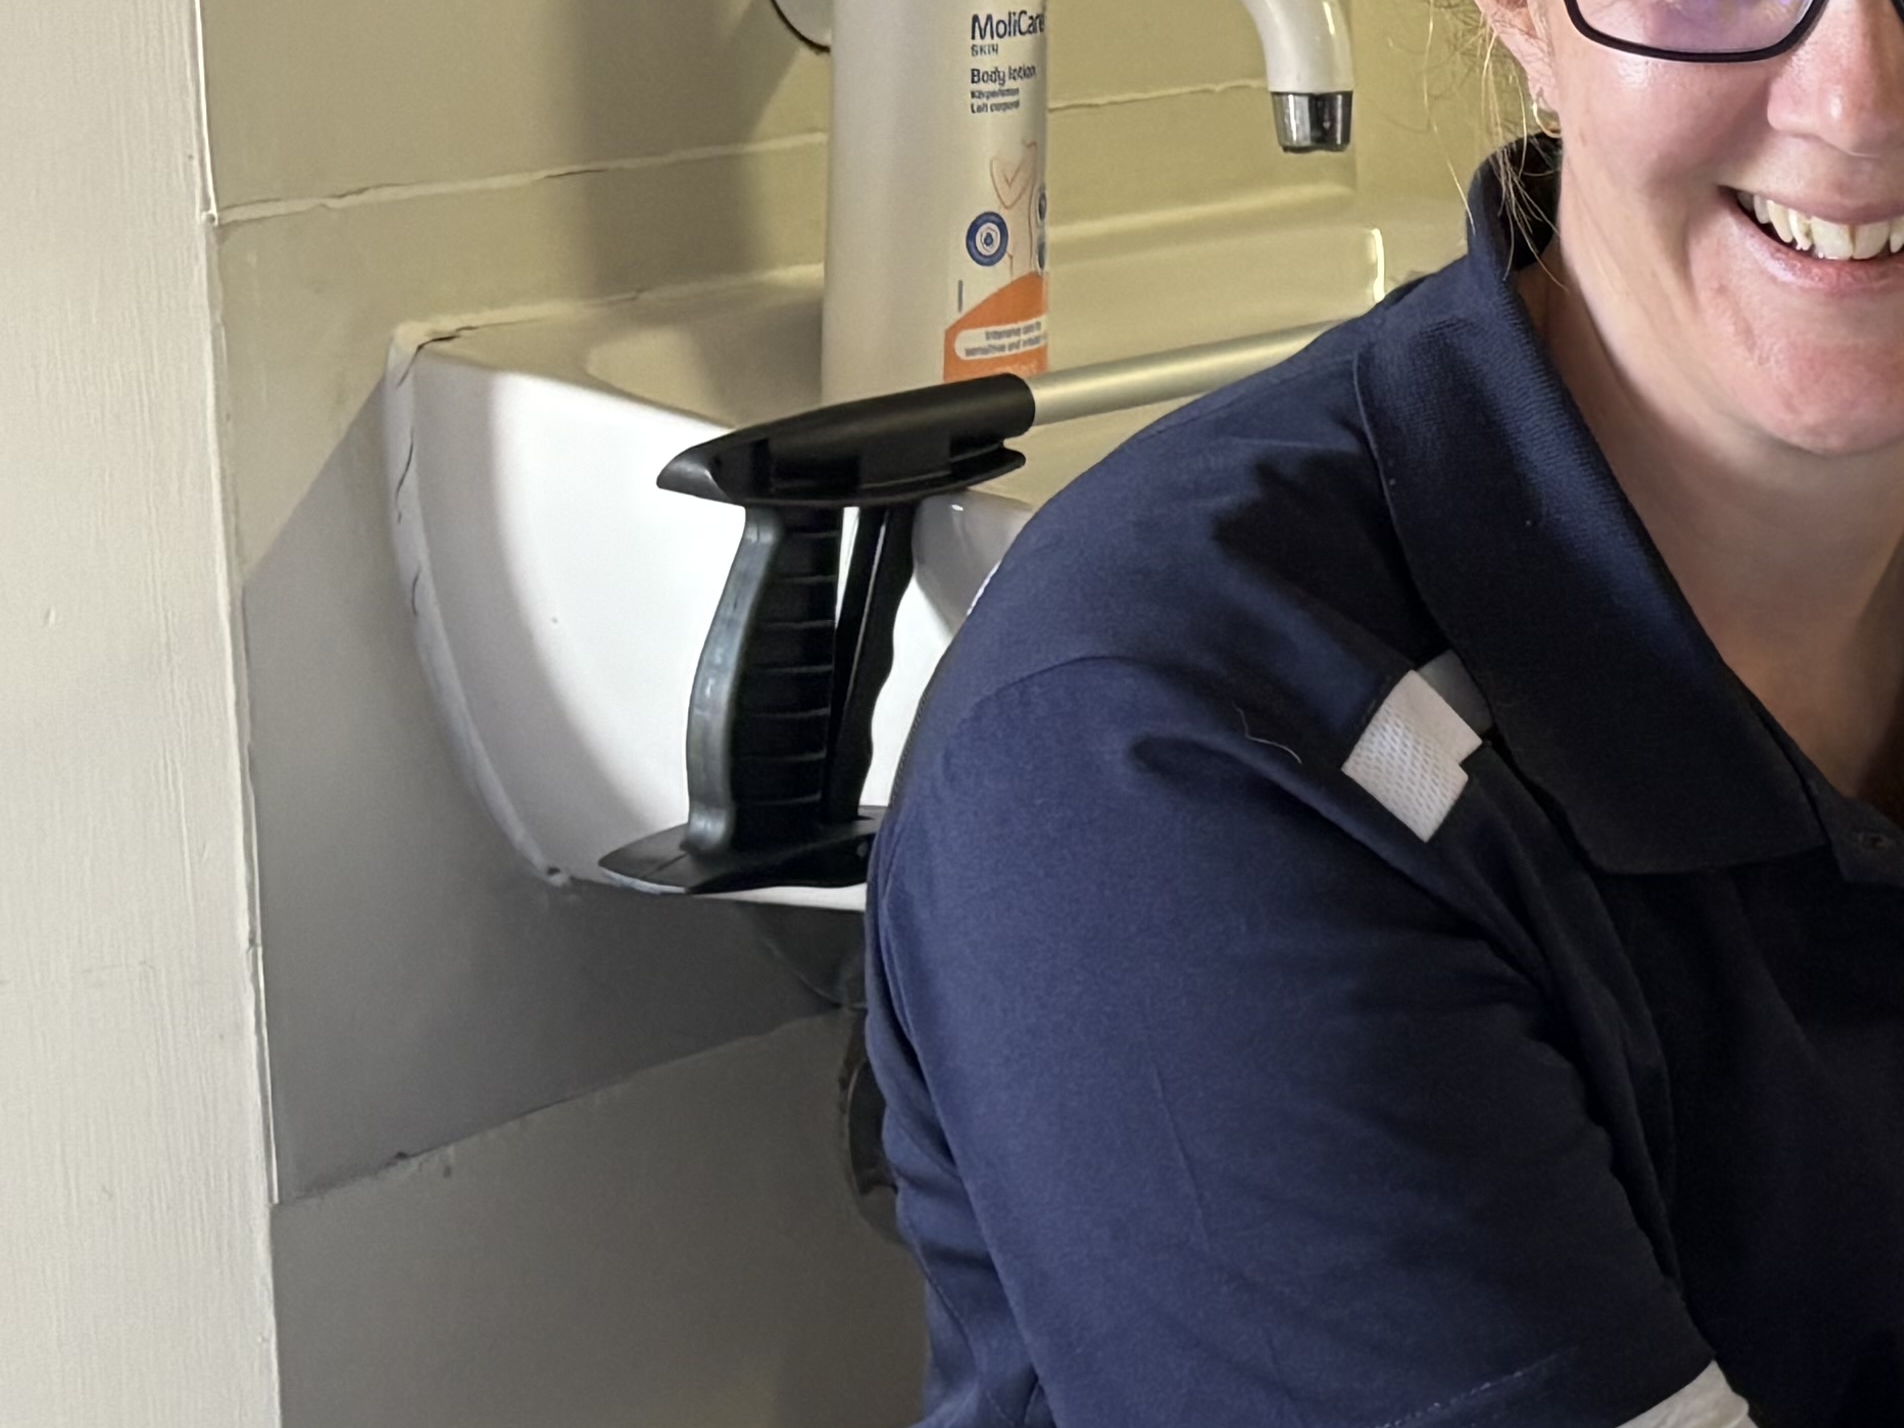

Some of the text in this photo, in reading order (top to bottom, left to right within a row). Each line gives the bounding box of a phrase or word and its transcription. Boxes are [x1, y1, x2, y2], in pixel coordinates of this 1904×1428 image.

[970, 43, 999, 57] SKIN
[970, 64, 1037, 87] Body lotion
